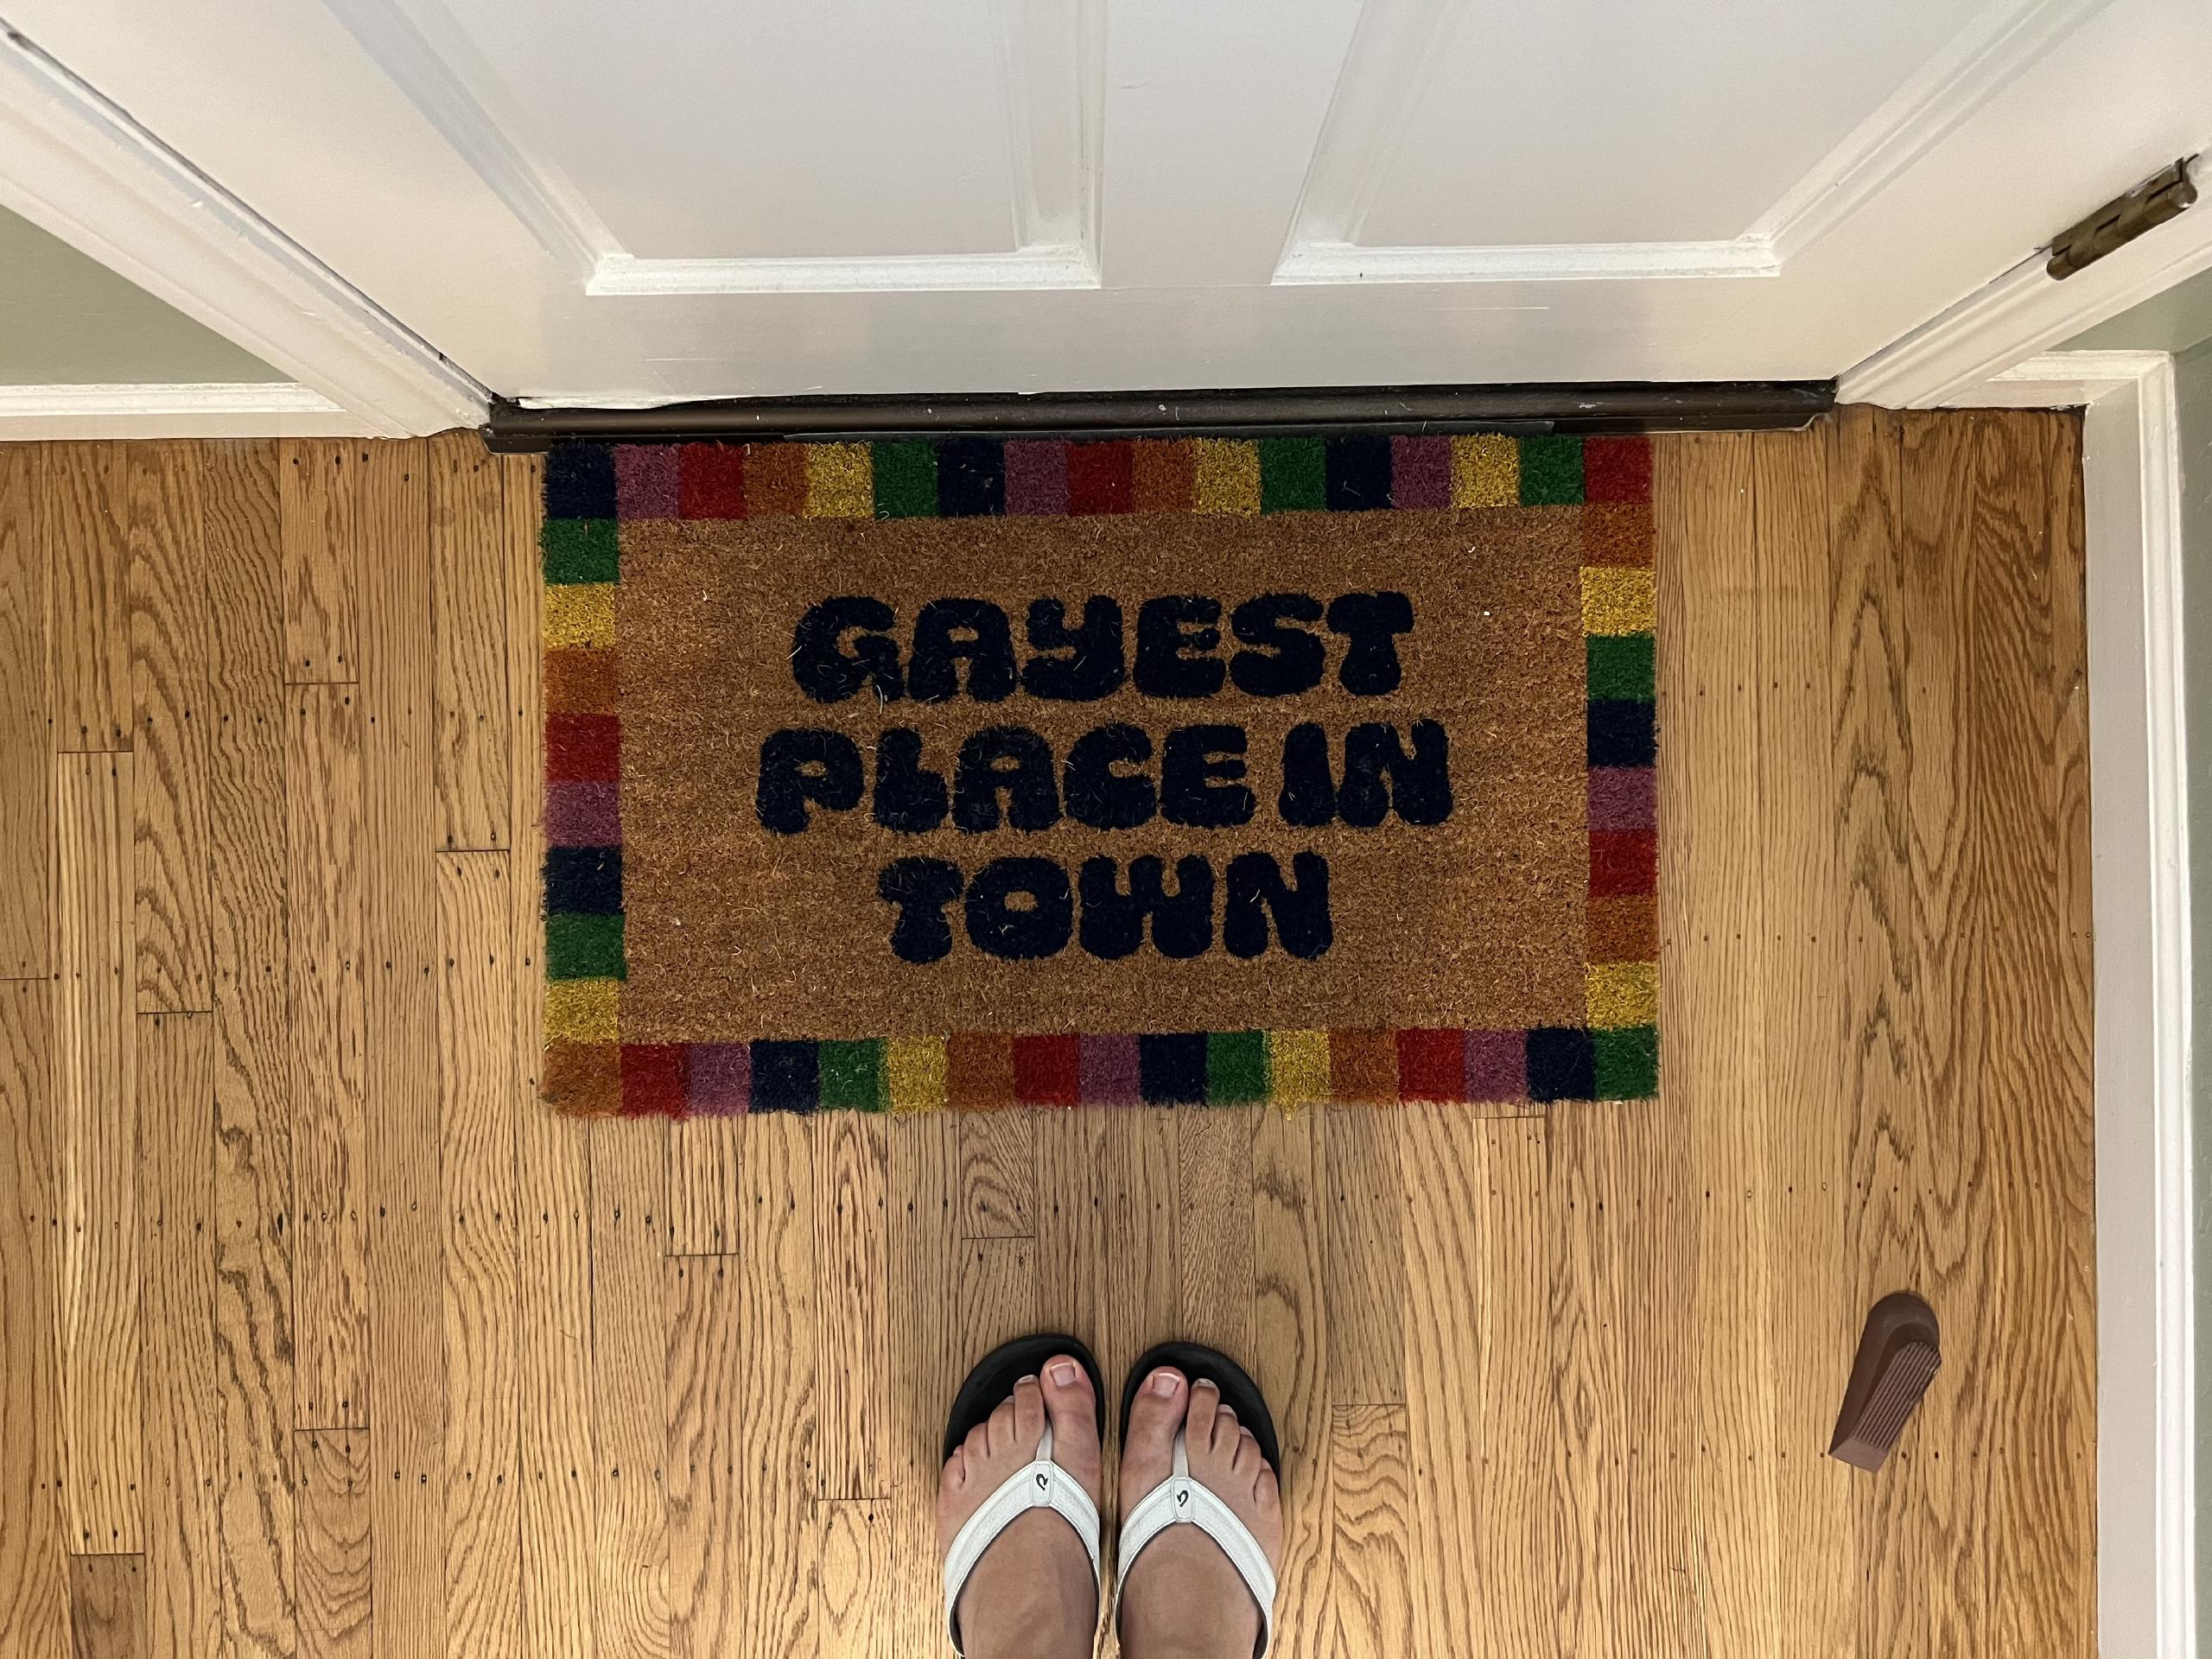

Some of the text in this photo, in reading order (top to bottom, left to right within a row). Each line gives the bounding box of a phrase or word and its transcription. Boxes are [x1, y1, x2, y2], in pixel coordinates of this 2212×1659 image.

[790, 589, 1415, 704] GAYEST
[755, 716, 1454, 836] PLACE IN
[876, 849, 1334, 966] TOWN
